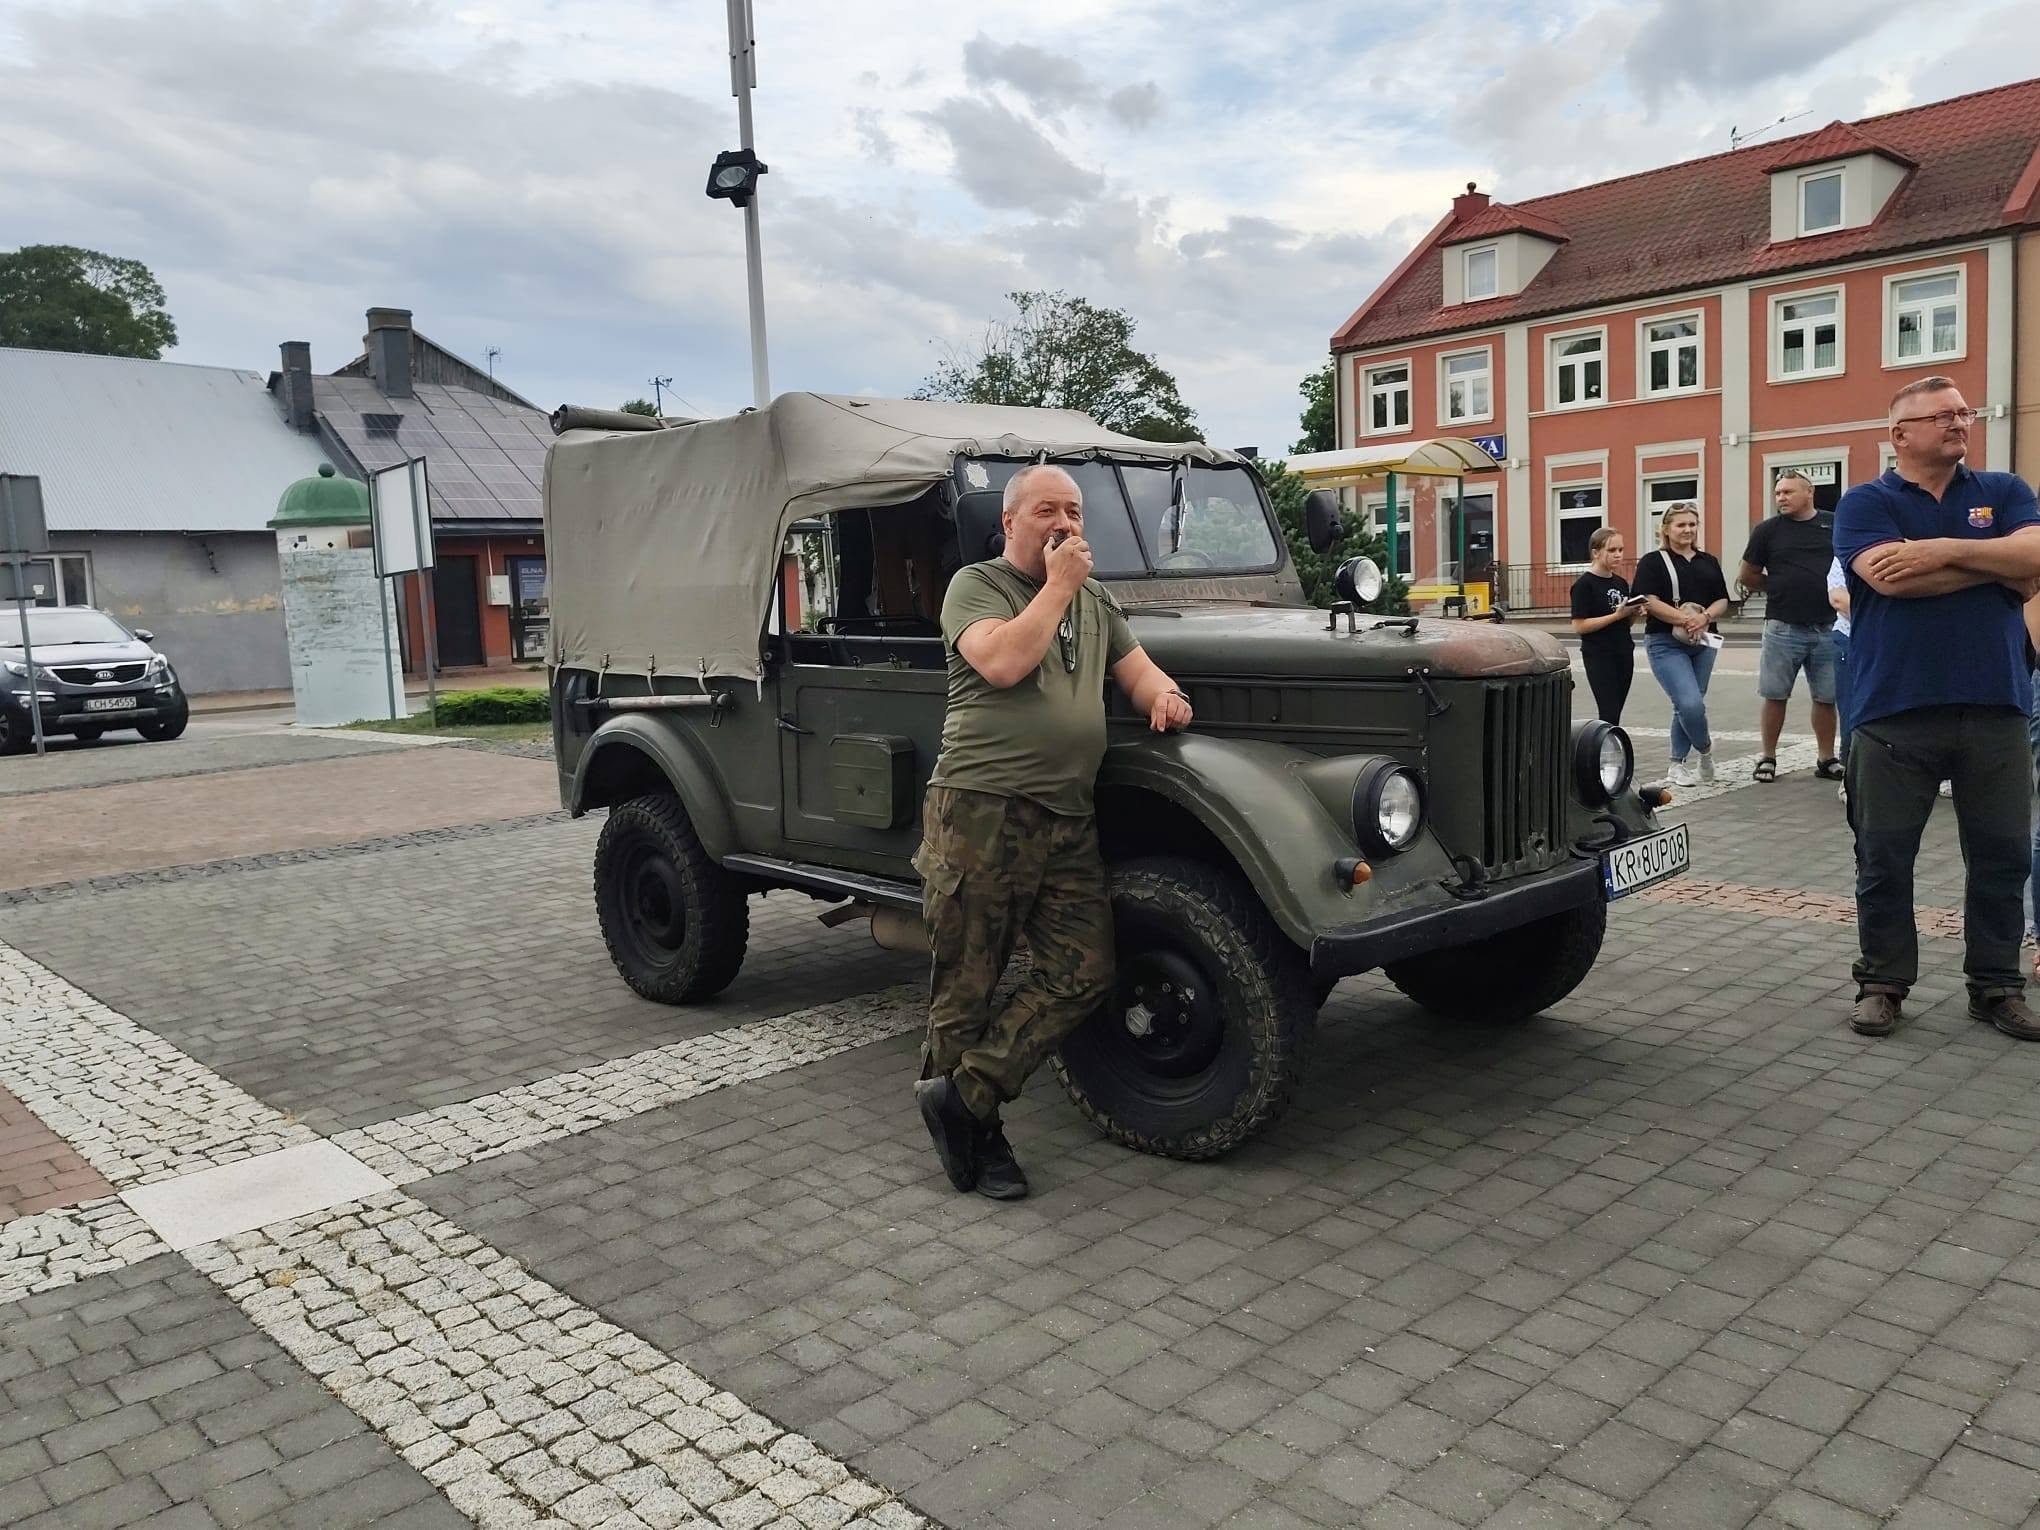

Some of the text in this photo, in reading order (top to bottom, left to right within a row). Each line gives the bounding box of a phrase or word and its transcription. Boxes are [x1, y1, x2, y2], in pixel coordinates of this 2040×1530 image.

[97, 671, 113, 679] KIA
[1614, 849, 1638, 887] KR
[1641, 832, 1685, 876] 8UP08
